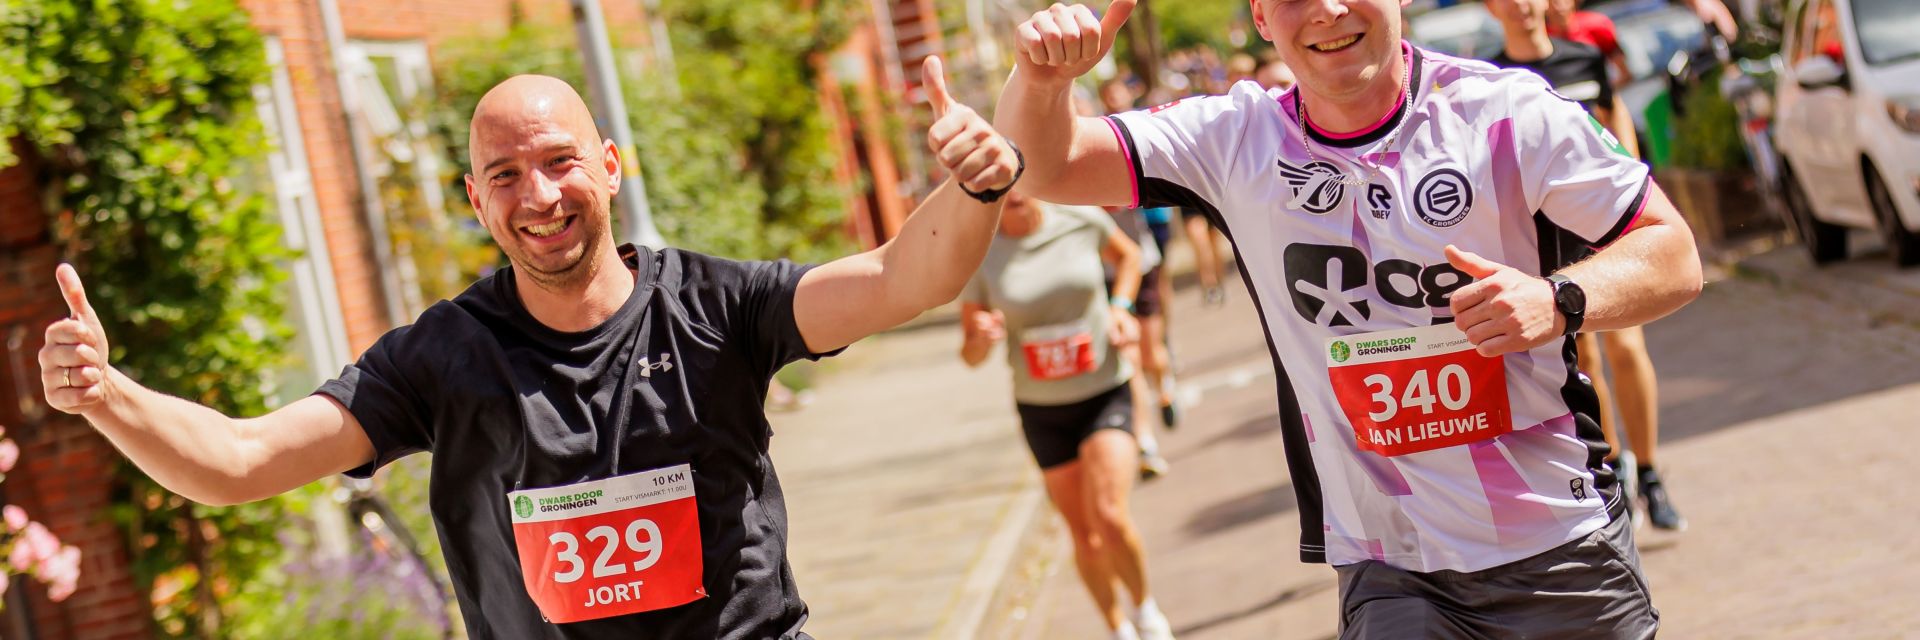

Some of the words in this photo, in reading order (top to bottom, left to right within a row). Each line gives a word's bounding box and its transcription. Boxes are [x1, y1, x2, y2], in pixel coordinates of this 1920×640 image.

[1433, 206, 1470, 227] GRONINGEN
[1356, 339, 1388, 349] DWARS
[1391, 336, 1416, 345] DOOR
[1358, 344, 1411, 356] GRONINGEN
[1427, 342, 1444, 350] START
[1445, 338, 1468, 347] VISMAR
[1363, 363, 1471, 423] 340
[1408, 412, 1489, 442] LIEUWE
[652, 476, 665, 486] 10
[668, 472, 685, 483] KM
[539, 495, 572, 505] DWARS
[574, 489, 603, 500] DOOR
[614, 494, 633, 503] START
[540, 498, 597, 512] GRONINGEN
[549, 518, 663, 583] 329
[584, 581, 643, 607] JORT
